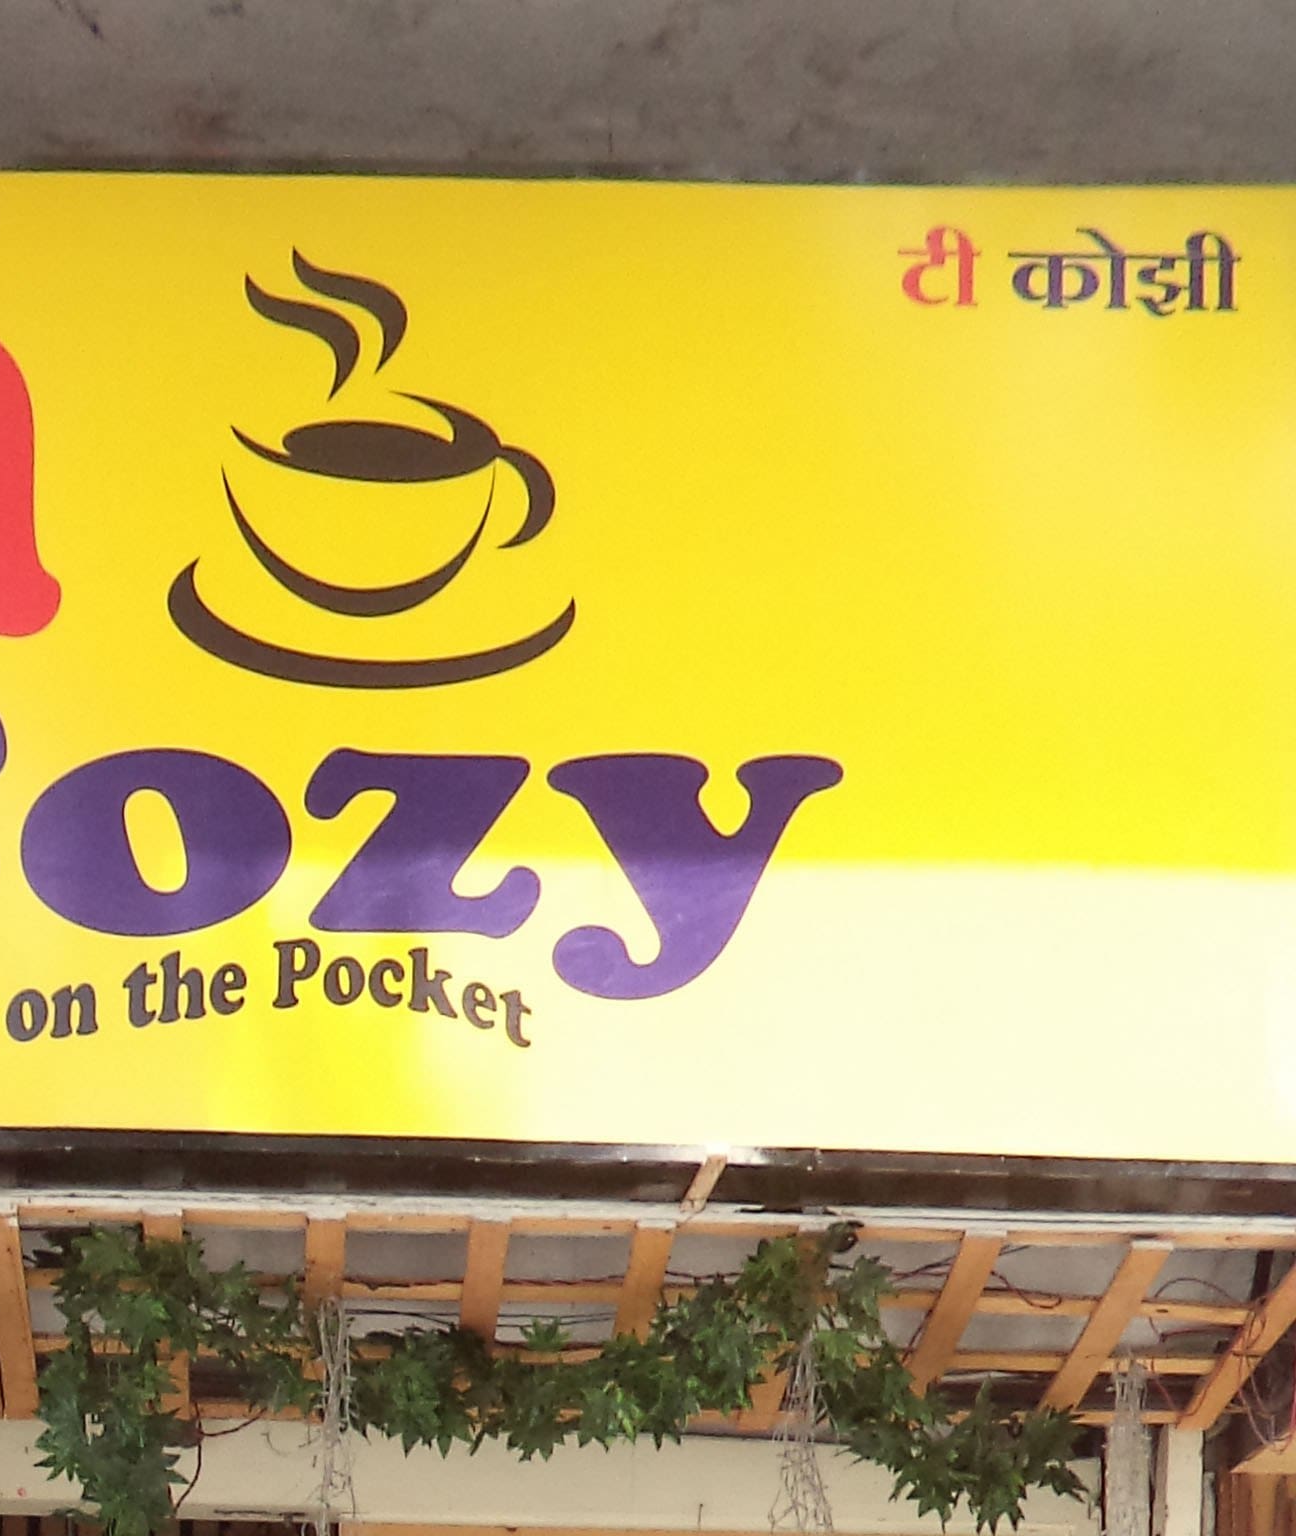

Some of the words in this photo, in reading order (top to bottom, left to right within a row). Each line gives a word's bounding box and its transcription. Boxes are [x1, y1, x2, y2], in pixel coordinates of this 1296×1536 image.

[898, 225, 982, 308] टी
[1007, 226, 1242, 316] कोझी
[4, 982, 99, 1041] on
[122, 950, 247, 1028] the
[271, 938, 532, 1048] Pocket
